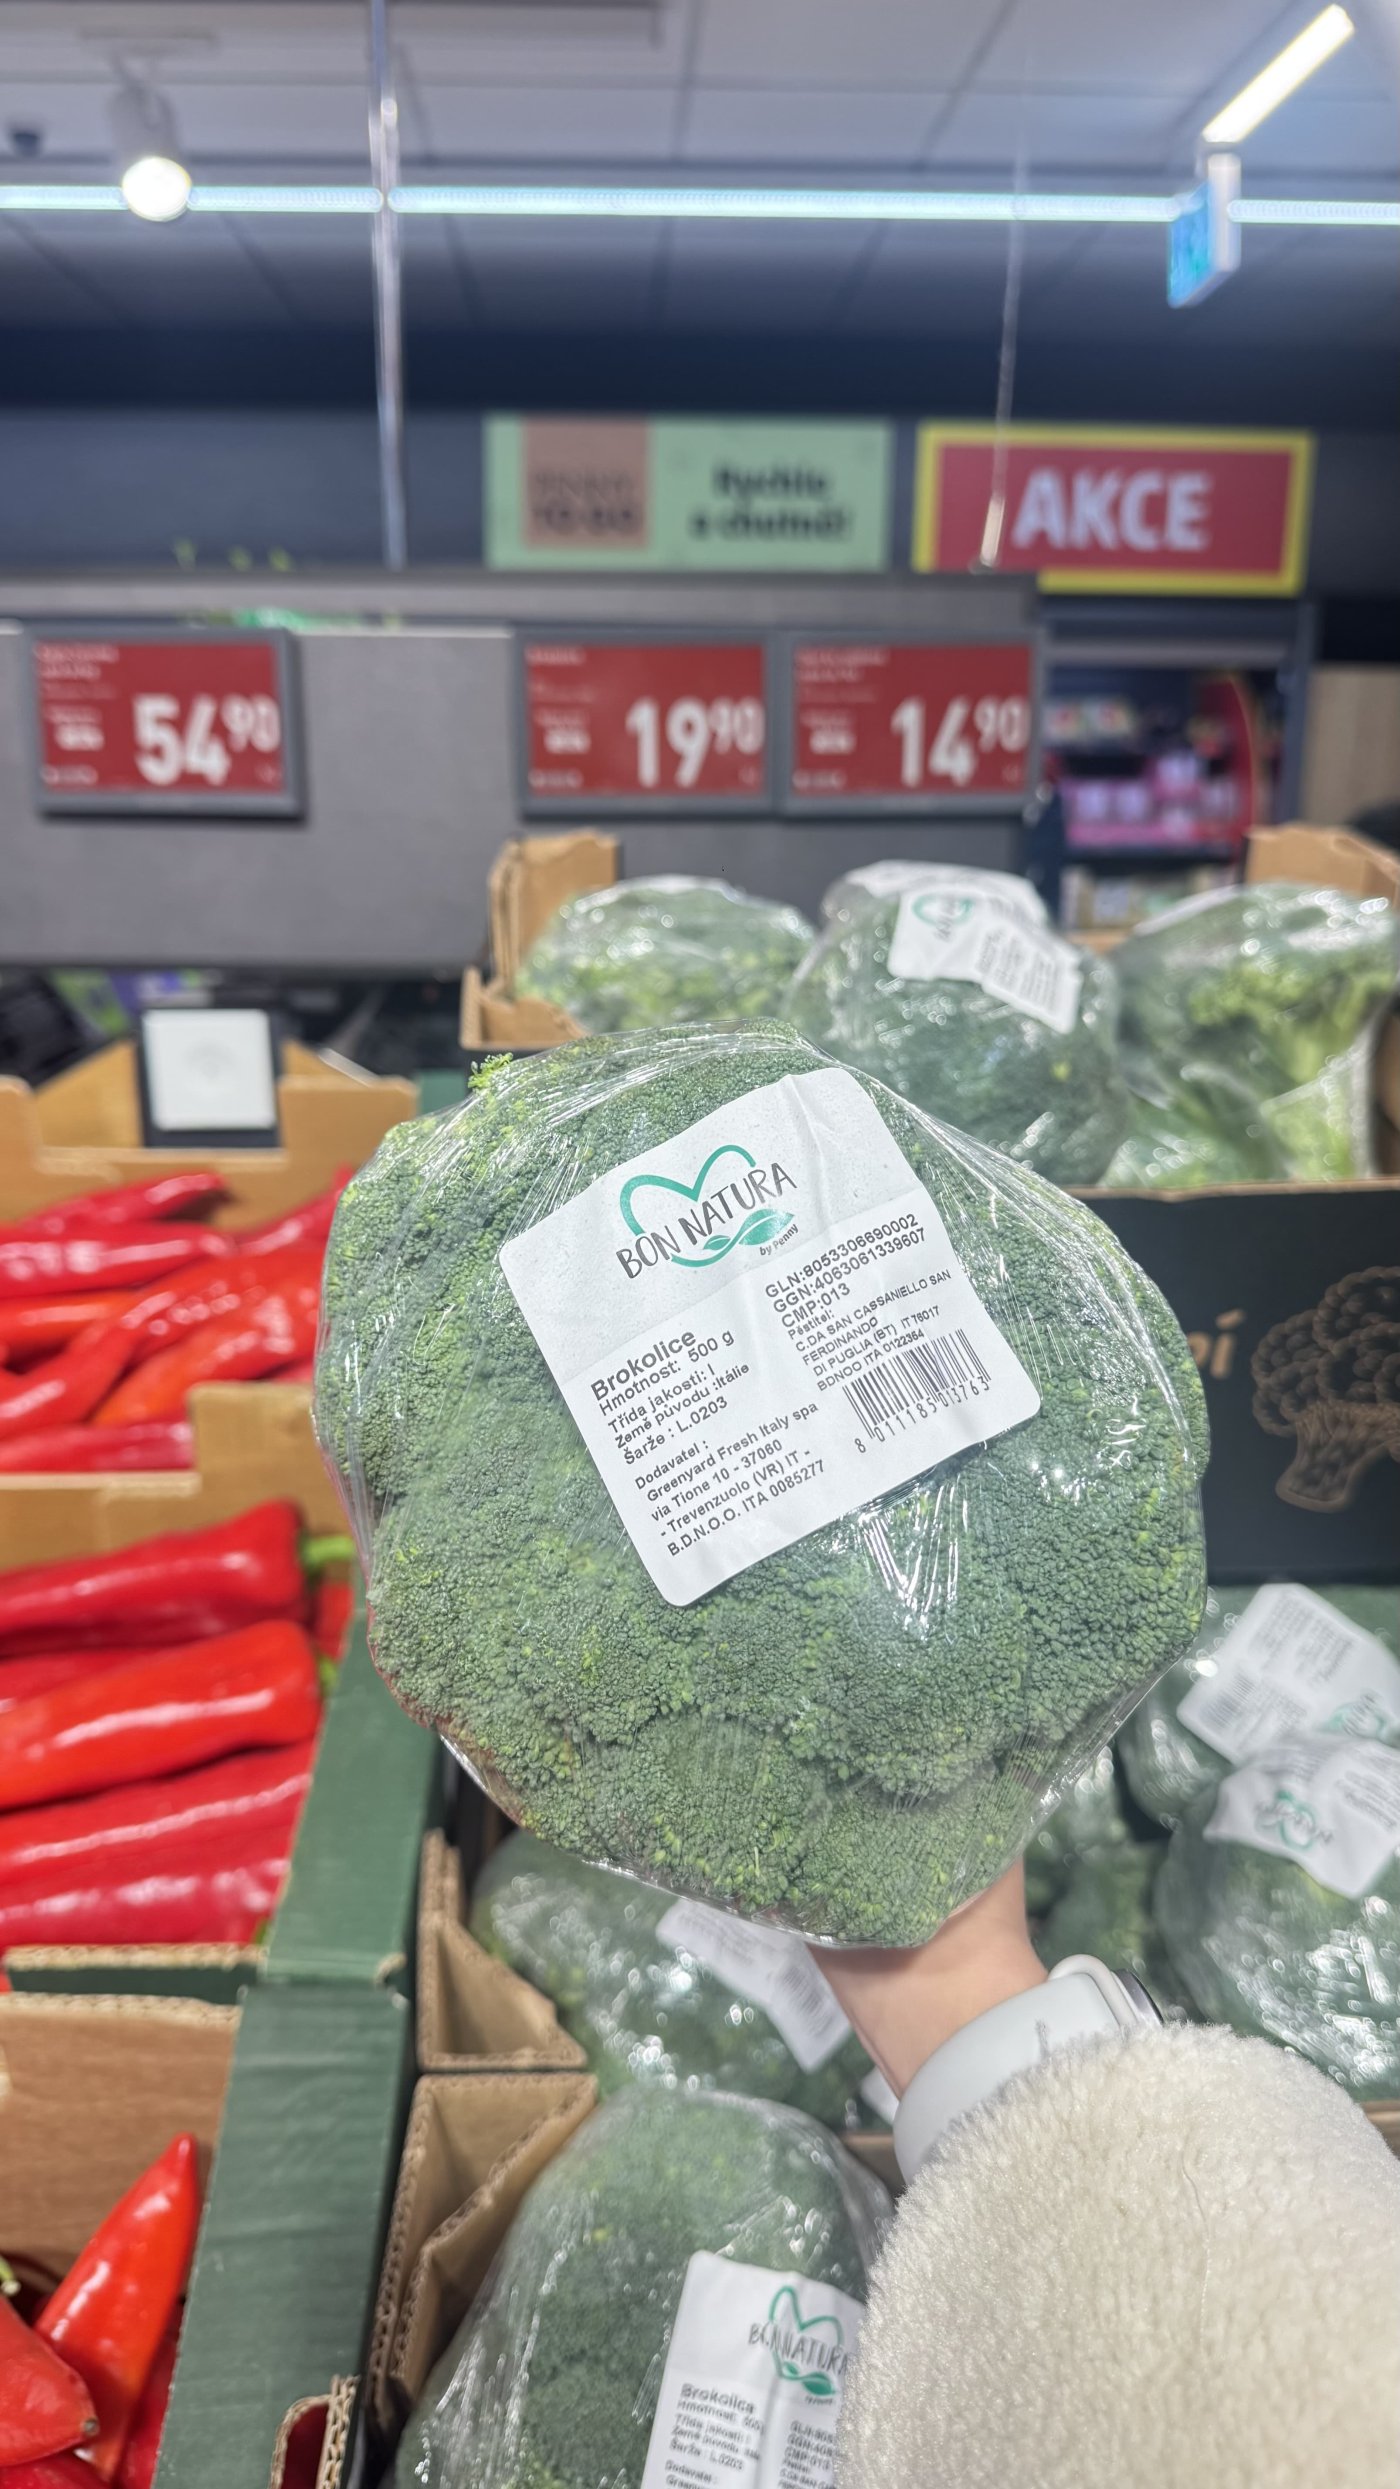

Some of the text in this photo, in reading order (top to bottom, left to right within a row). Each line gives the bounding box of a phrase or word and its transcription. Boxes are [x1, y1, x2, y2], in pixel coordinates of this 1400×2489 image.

[1011, 467, 1213, 552] AKCE
[616, 1163, 797, 1278] BON NATURA
[760, 1224, 799, 1255] by Penny
[766, 1214, 918, 1297] GLN:8053306690002
[774, 1227, 925, 1312] GGN:4063061339607
[782, 1283, 850, 1327] CMP:013
[796, 1269, 951, 1351] C.DA SAN CASSANIELLO SAN
[803, 1316, 879, 1365] FERDINANDO
[813, 1305, 939, 1376] DI PUGLIA (BT) IT 76017
[591, 1332, 697, 1401] Brokolice
[598, 1331, 734, 1416] Hmotnost: 500 g
[817, 1328, 924, 1391] BDNOO ITA 0122364
[608, 1406, 647, 1433] Třída
[648, 1371, 706, 1412] jakosti:
[615, 1417, 652, 1448] Země
[655, 1387, 710, 1425] původu
[624, 1435, 665, 1464] Šarže
[676, 1396, 727, 1432] L.0203
[635, 1443, 700, 1489] Dodavatel
[647, 1404, 818, 1501] Greenyard Fresh Italy spa
[652, 1506, 671, 1521] via
[671, 1481, 710, 1507] Tione
[713, 1468, 729, 1483] 10
[741, 1439, 782, 1468] 37060
[667, 1481, 750, 1532] Trevenzuolo
[753, 1460, 784, 1486] (VR)
[785, 1450, 798, 1466] IT
[668, 1459, 823, 1556] B.D.N.O.O. ITA 0085277
